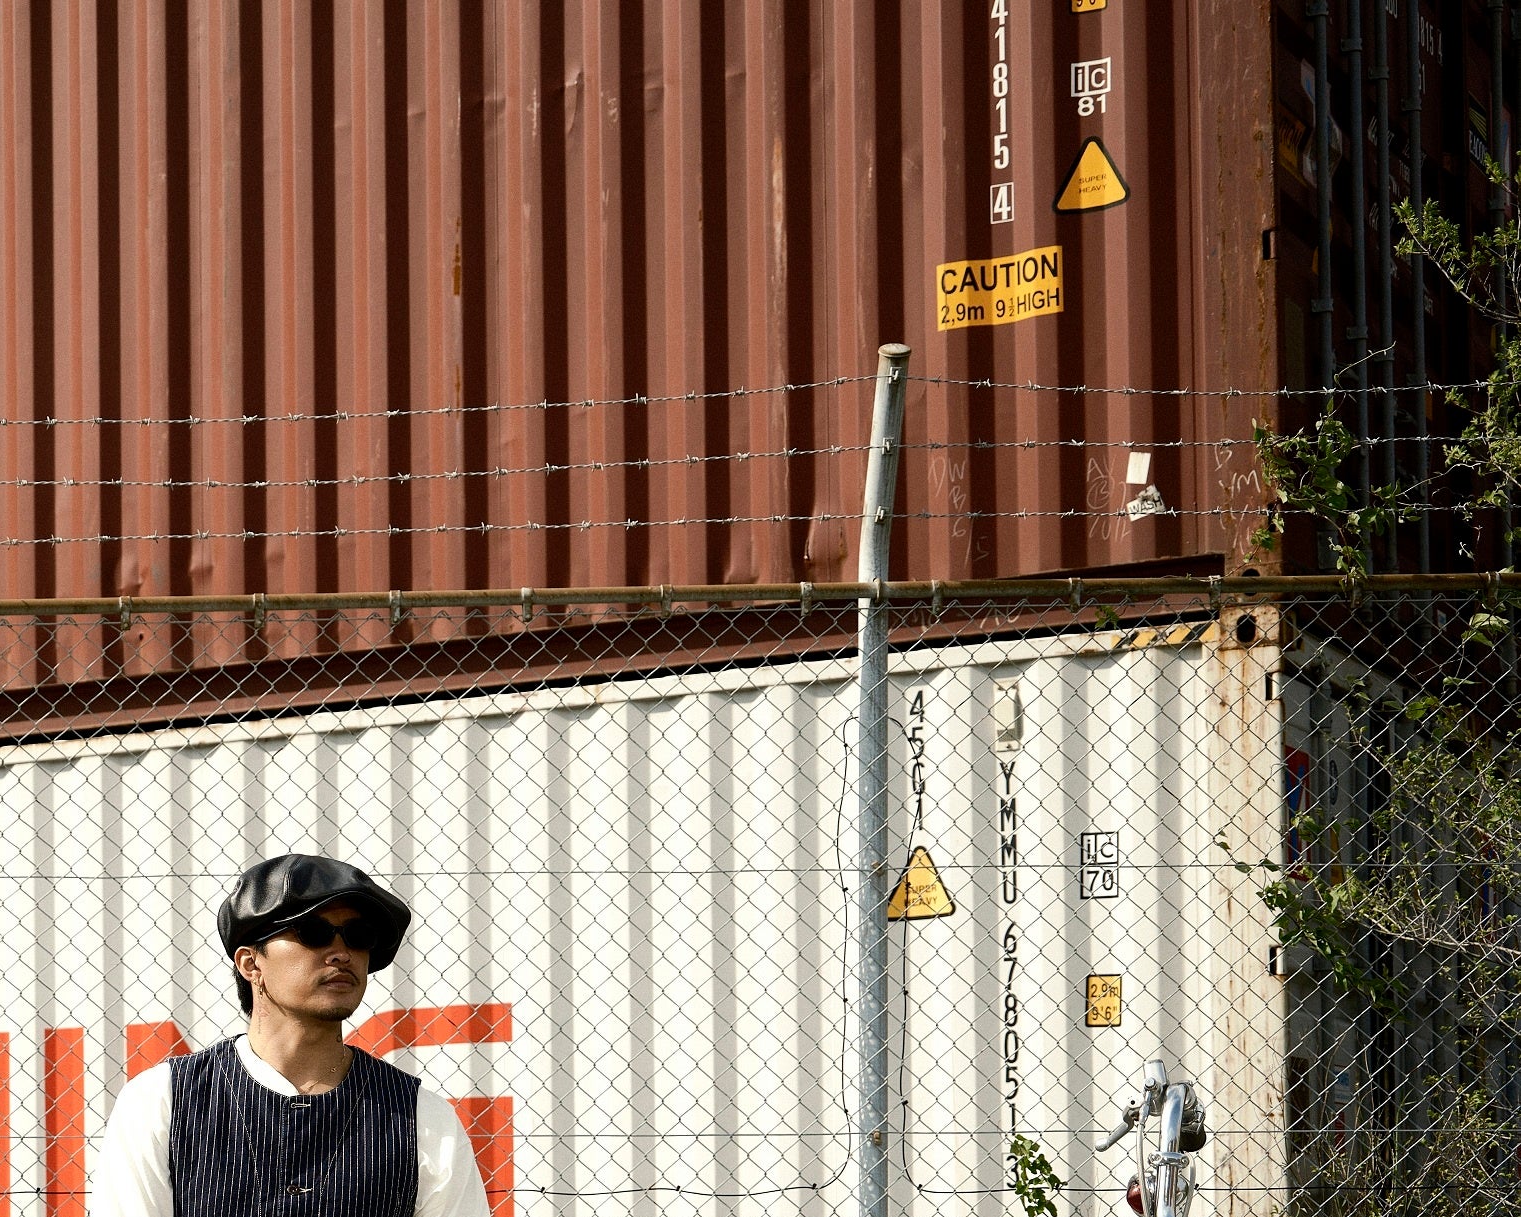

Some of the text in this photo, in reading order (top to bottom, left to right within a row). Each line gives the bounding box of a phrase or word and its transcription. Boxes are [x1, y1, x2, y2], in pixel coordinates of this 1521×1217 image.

[1077, 93, 1107, 117] 81
[1078, 173, 1107, 185] SUPER
[1078, 183, 1108, 194] HEAVY
[941, 252, 1058, 295] CAUTION
[1086, 869, 1115, 892] 70
